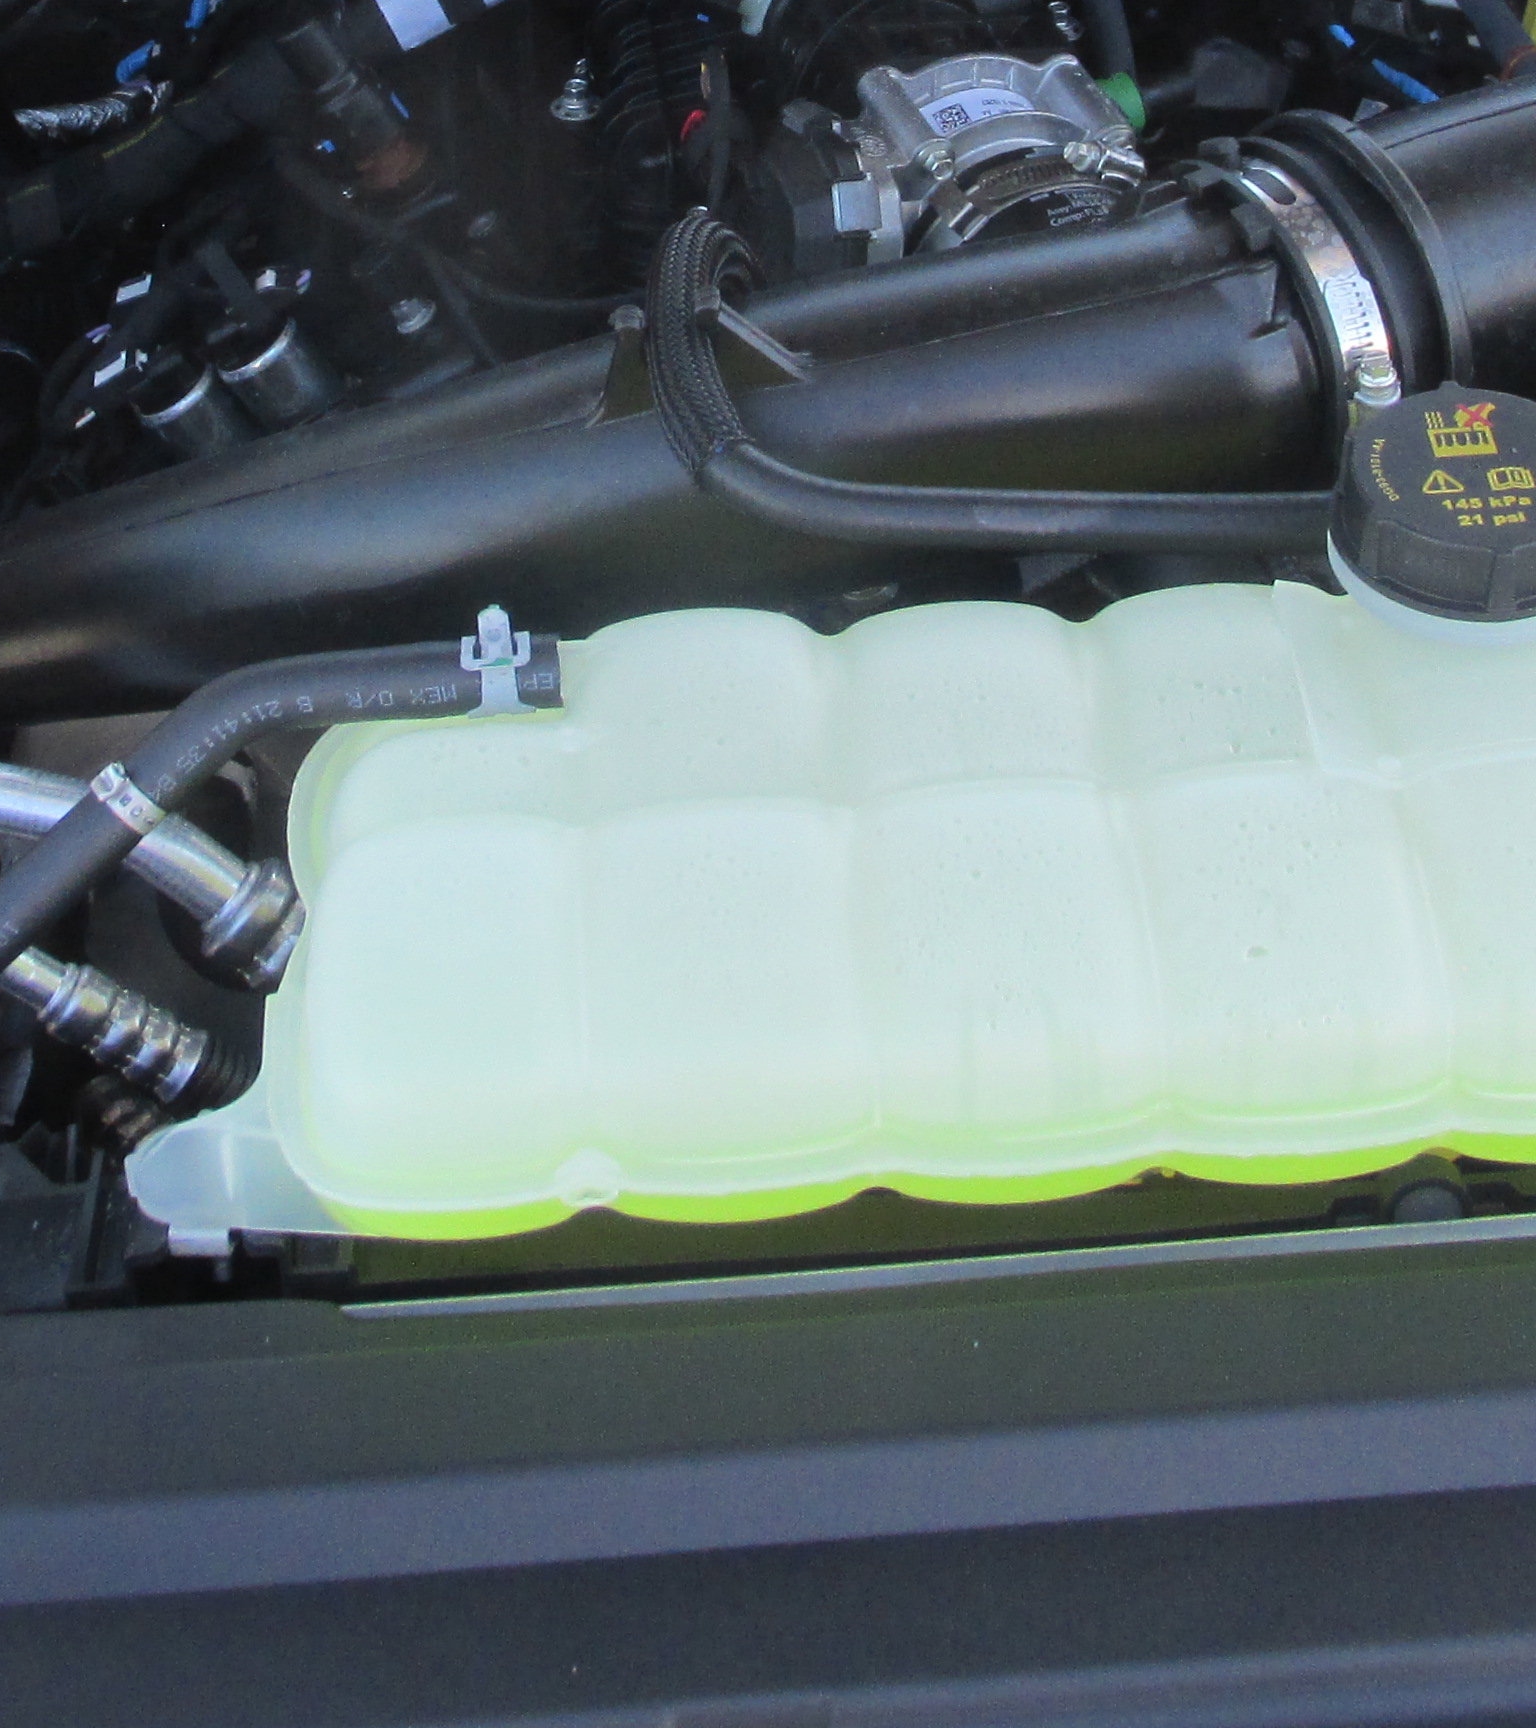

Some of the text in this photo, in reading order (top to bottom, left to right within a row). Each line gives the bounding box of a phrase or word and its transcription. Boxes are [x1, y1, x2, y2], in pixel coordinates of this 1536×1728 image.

[1441, 495, 1534, 512] 145 kPa
[1457, 511, 1527, 528] 21 psi
[409, 684, 457, 705] MEX
[296, 695, 313, 712] B
